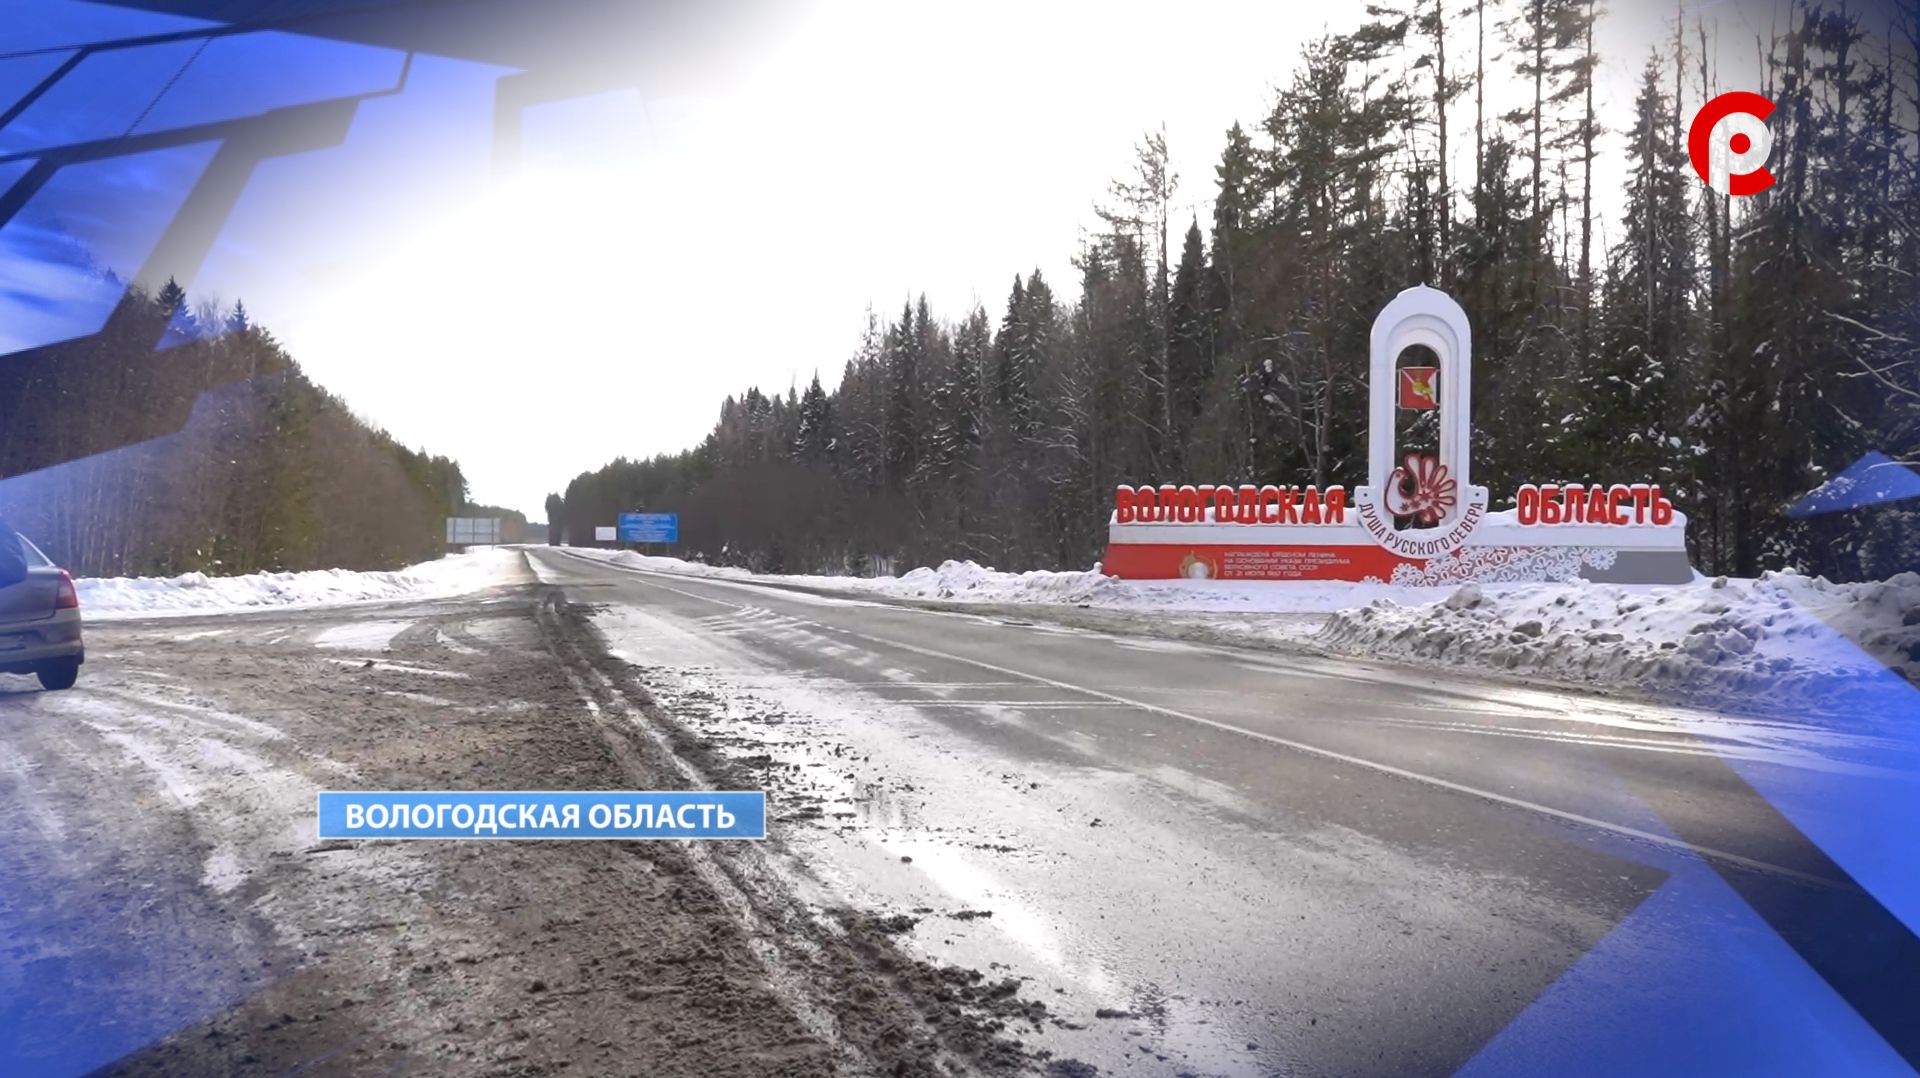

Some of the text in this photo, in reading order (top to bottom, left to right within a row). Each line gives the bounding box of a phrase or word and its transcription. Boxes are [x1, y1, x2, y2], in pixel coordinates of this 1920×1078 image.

[1116, 485, 1673, 526] ВОЛОГОДСКАЯ ОБЛАСТЬ
[1359, 502, 1484, 555] ДУША РУССКОГО СЕВЕРА
